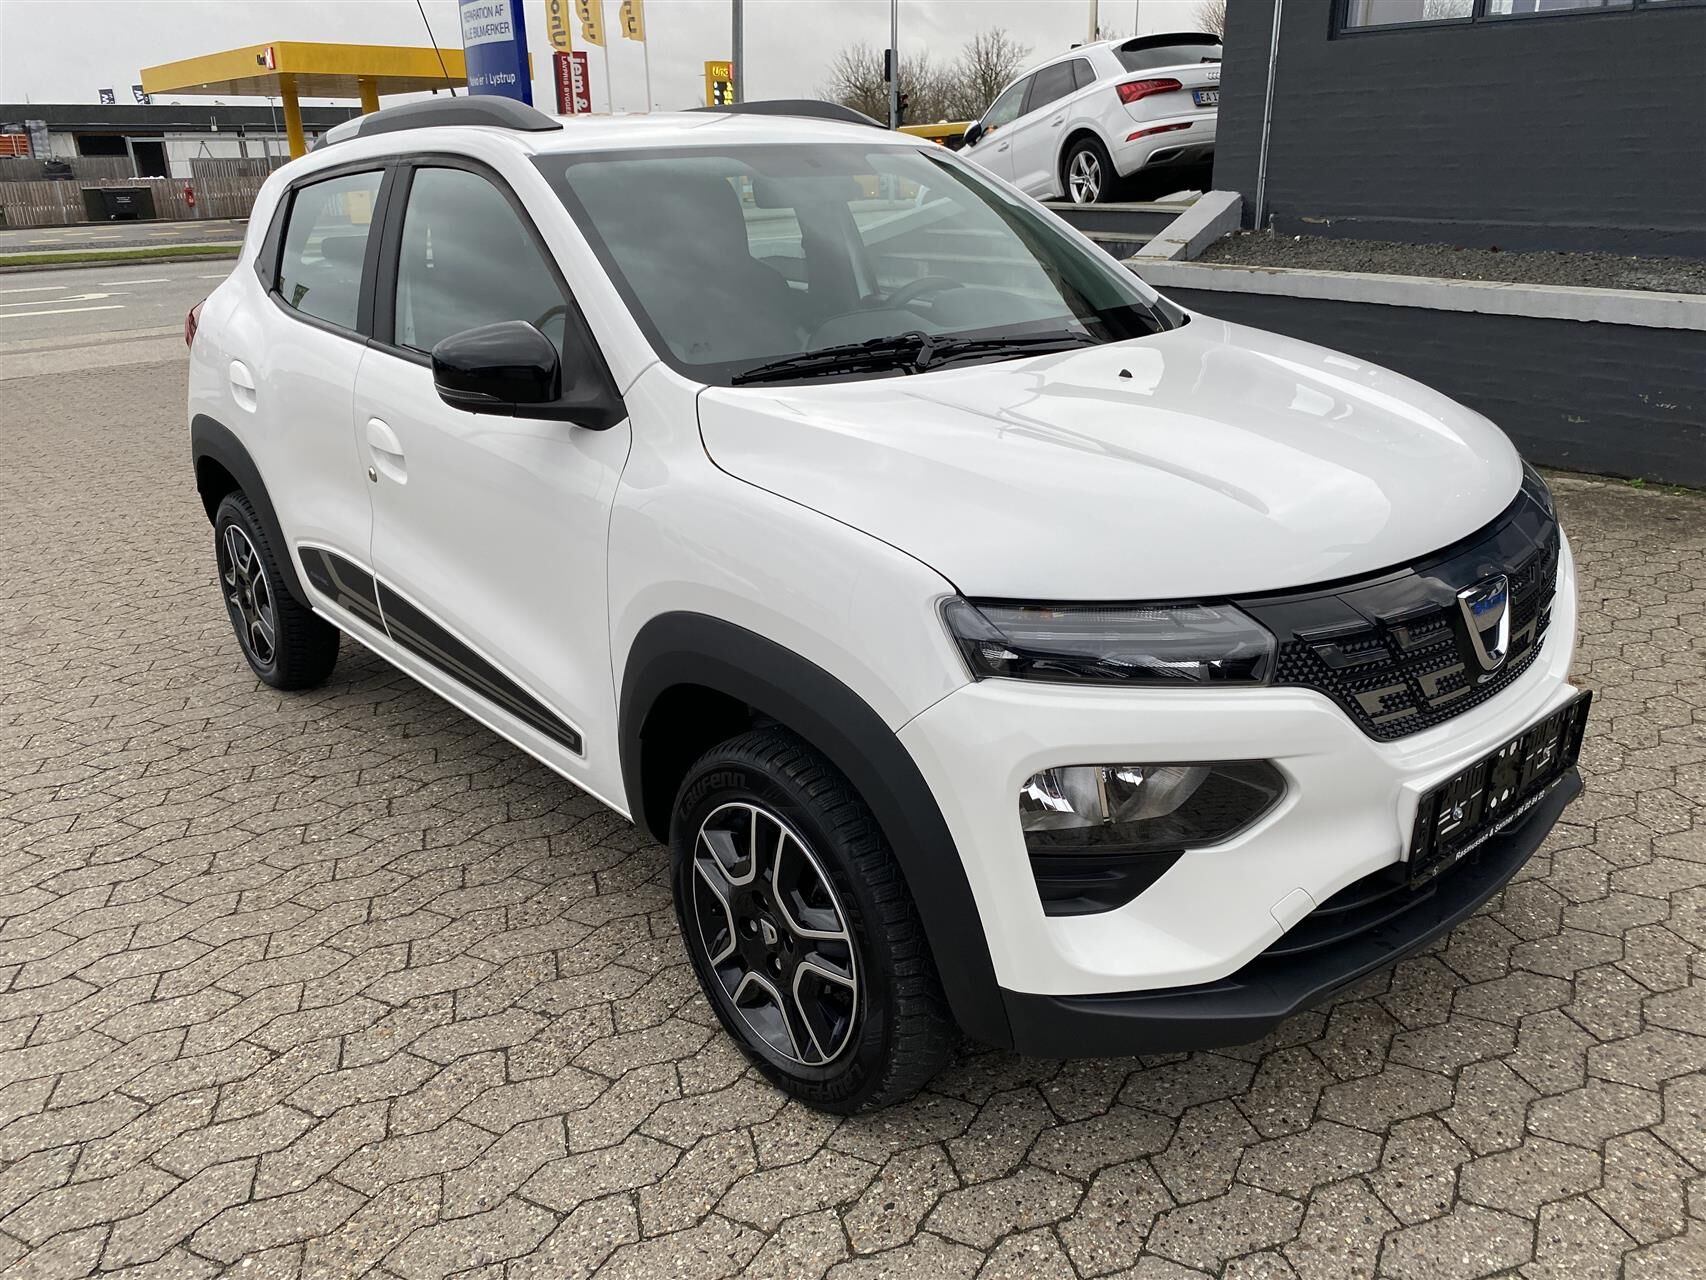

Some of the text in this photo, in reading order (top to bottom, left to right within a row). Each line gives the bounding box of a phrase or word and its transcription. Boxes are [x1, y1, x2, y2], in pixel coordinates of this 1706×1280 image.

[495, 4, 504, 17] AF
[489, 71, 516, 87] Lystrup
[567, 56, 585, 93] jem
[1200, 92, 1211, 102] EA
